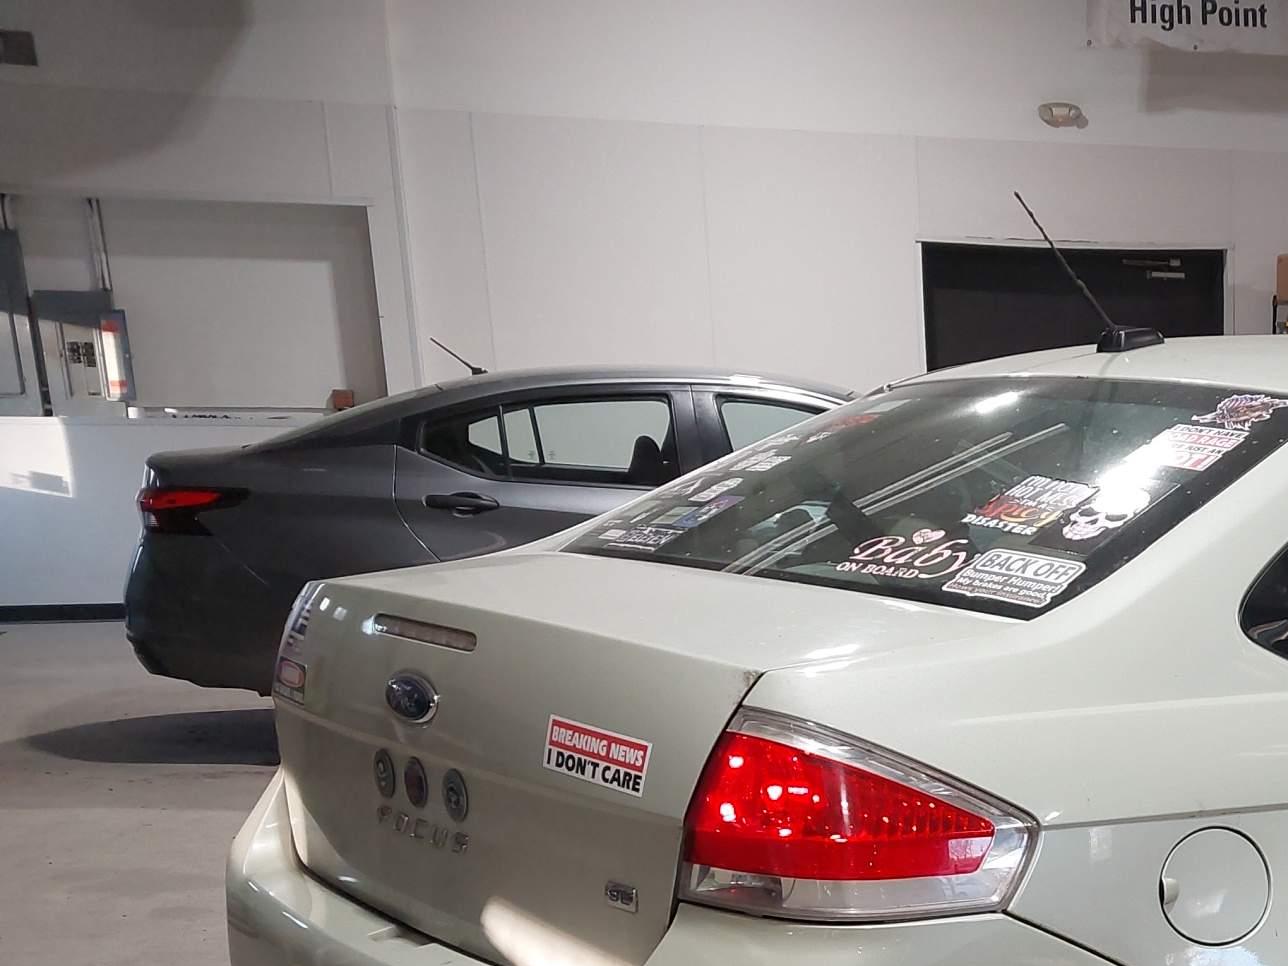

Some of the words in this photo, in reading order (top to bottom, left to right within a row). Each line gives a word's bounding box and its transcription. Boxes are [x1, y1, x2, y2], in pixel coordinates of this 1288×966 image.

[1130, 0, 1191, 31] High
[1201, 0, 1267, 28] Point
[1199, 435, 1238, 448] RAGE
[960, 513, 1039, 536] DISASTER
[836, 562, 862, 573] ON
[861, 563, 920, 578] BOARD
[849, 536, 980, 578] Baby
[980, 553, 1036, 576] BACK
[1032, 562, 1077, 581] OFF
[962, 569, 1008, 583] Bumper
[551, 726, 608, 756] BREAKING
[609, 742, 644, 766] NEWS
[546, 748, 552, 765] I
[555, 751, 599, 779] DON'T
[601, 766, 643, 792] CARE
